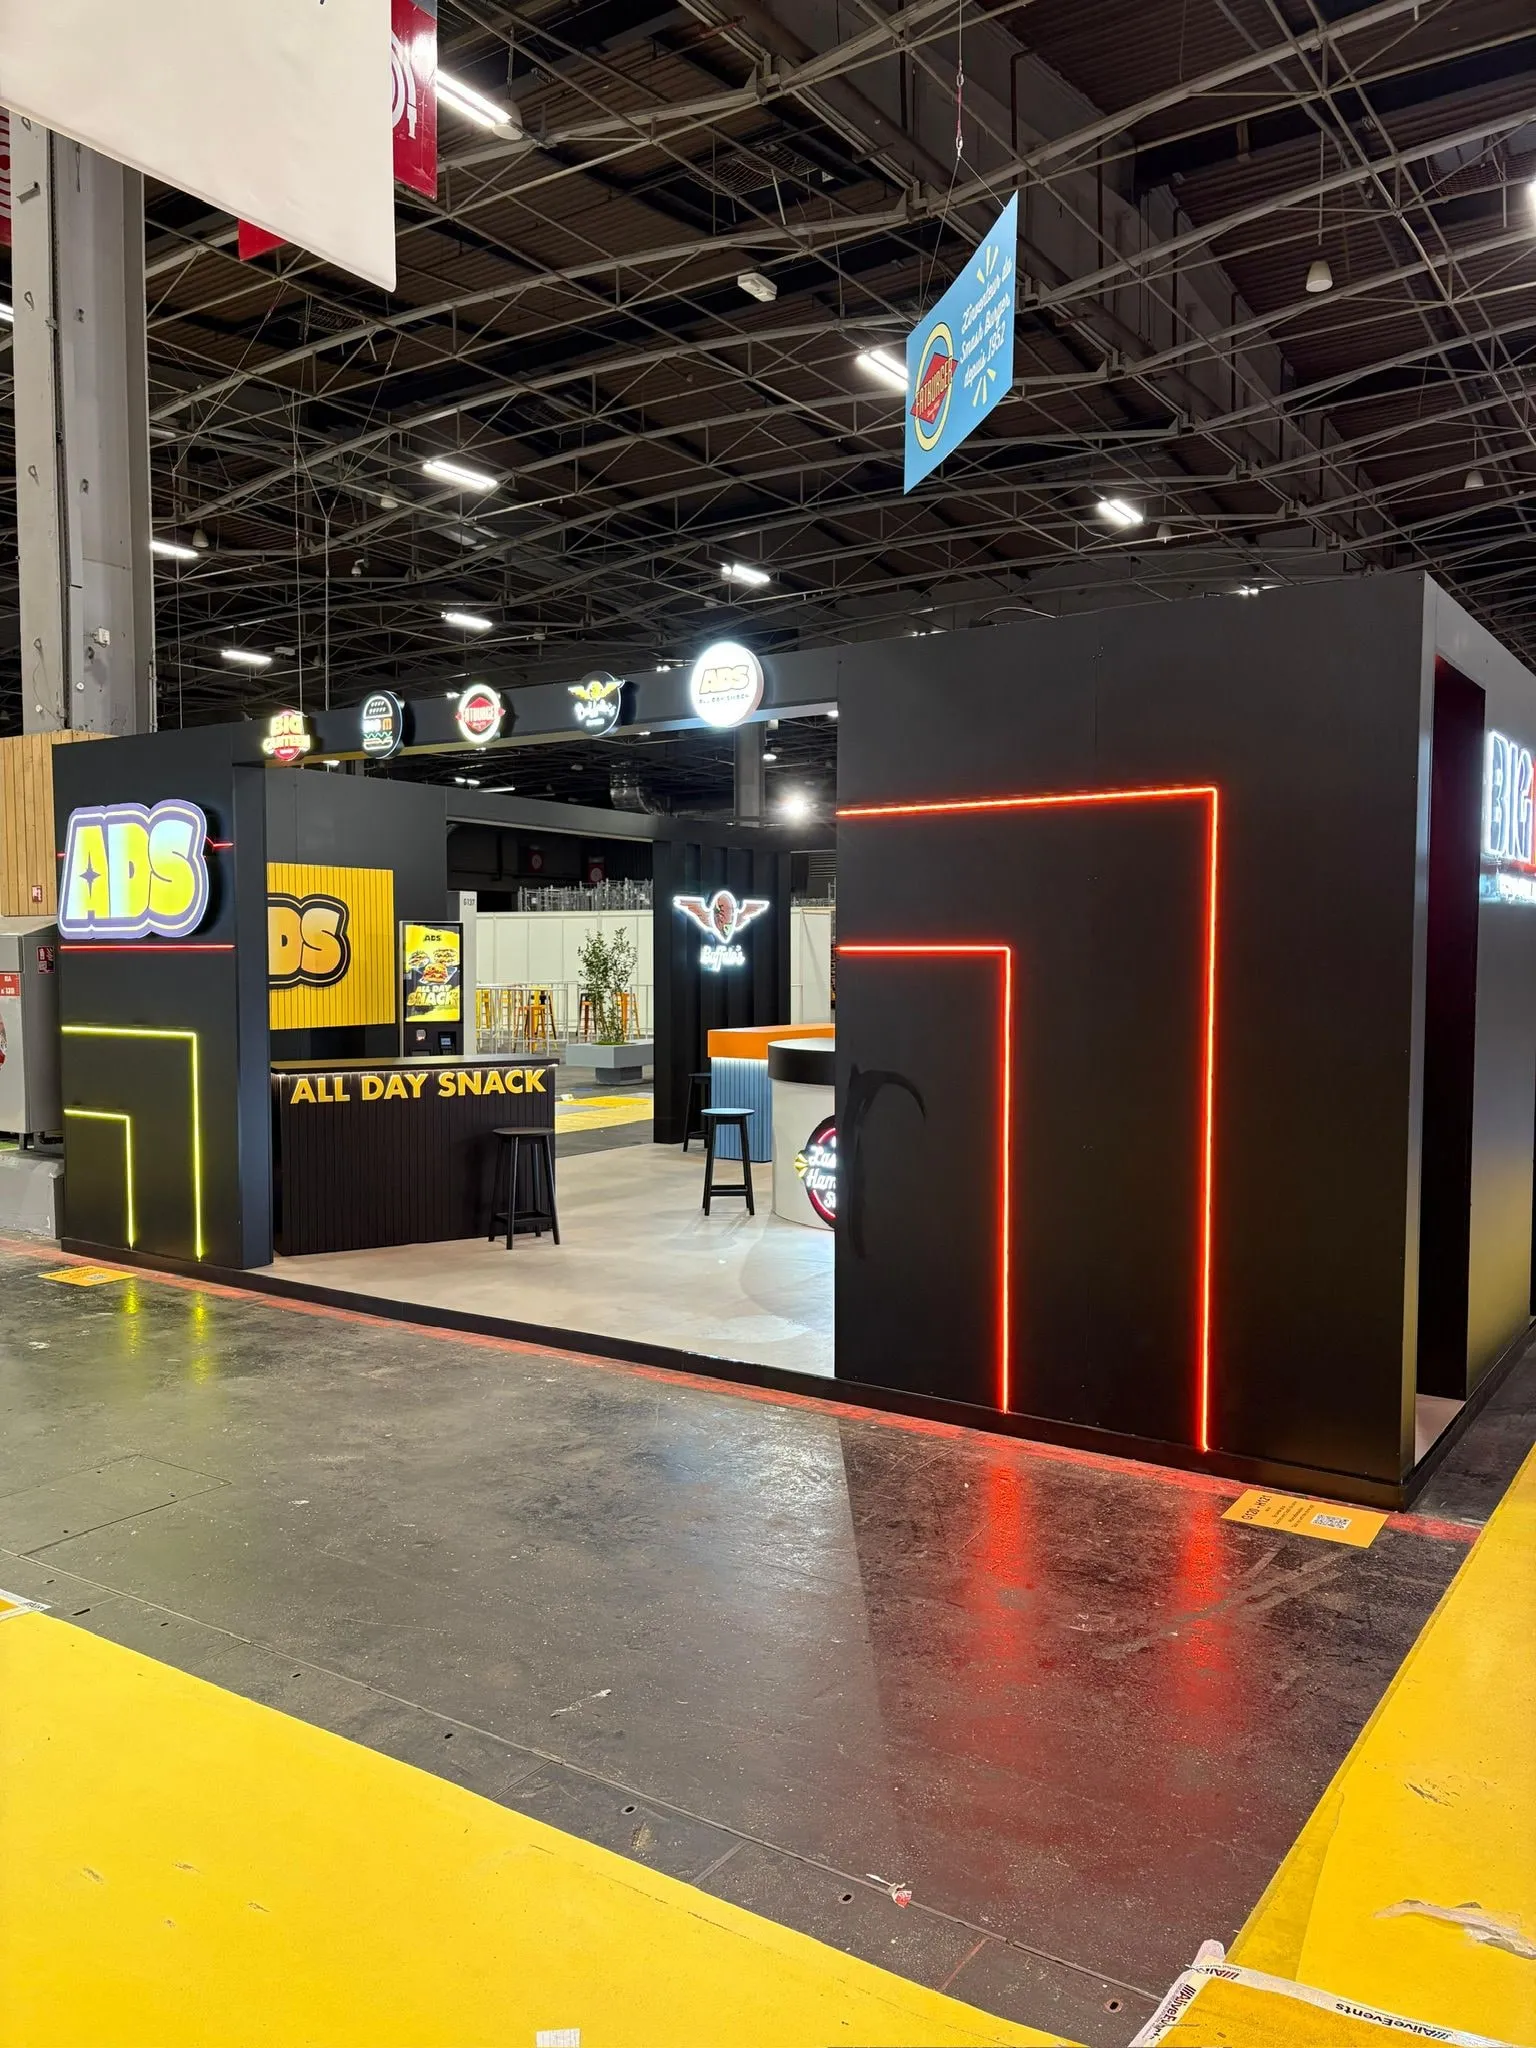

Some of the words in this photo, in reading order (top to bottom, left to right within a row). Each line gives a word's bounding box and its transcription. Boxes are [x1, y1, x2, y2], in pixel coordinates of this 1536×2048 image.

[915, 356, 953, 419] FATBURGER
[270, 714, 306, 737] BIG
[1483, 731, 1533, 864] BIG
[63, 813, 199, 924] ADS
[267, 901, 345, 980] DS
[423, 934, 442, 942] ADS
[407, 991, 457, 1006] SNACK
[416, 985, 431, 993] ALL
[431, 984, 452, 993] DAY
[290, 1077, 350, 1105] ALL
[362, 1073, 429, 1101] DAY
[438, 1068, 547, 1098] SNACK
